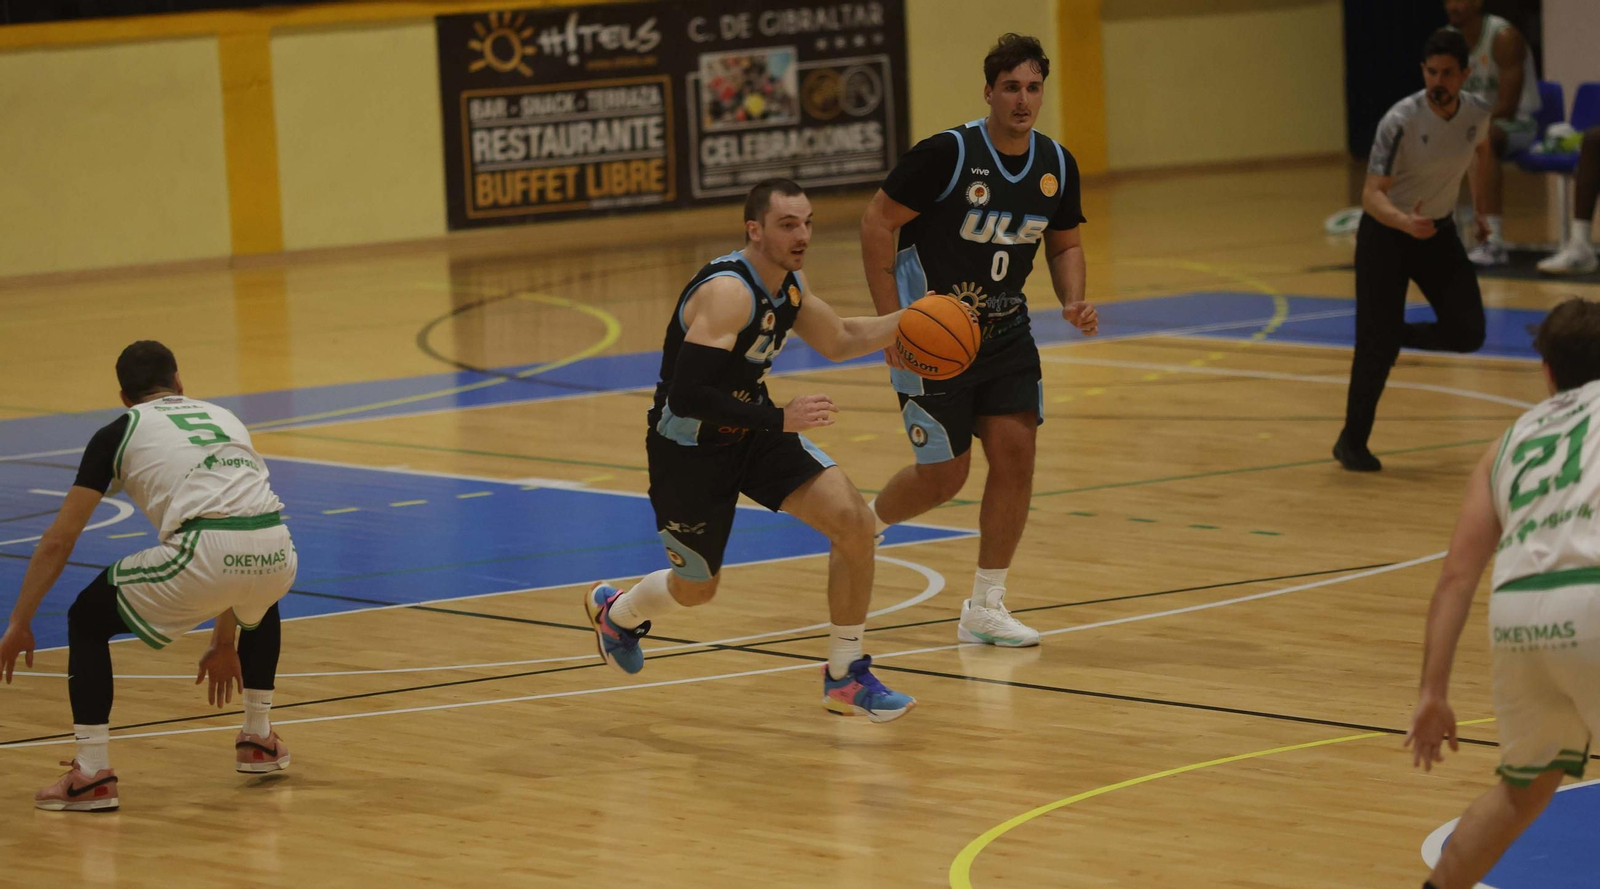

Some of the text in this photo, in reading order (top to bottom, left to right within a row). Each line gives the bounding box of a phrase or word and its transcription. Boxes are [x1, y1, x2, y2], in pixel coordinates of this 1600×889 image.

[719, 12, 751, 40] DE
[472, 116, 664, 164] RESTAURANTE
[701, 121, 884, 166] CELEBRACIONES
[475, 166, 579, 208] BUFFET
[586, 159, 665, 198] LIBRE
[970, 167, 990, 177] vive
[990, 250, 1010, 282] 0
[166, 412, 231, 447] 5
[1508, 414, 1591, 512] 21
[223, 548, 287, 568] OKEYMAS
[1493, 621, 1576, 643] OKEYMAS
